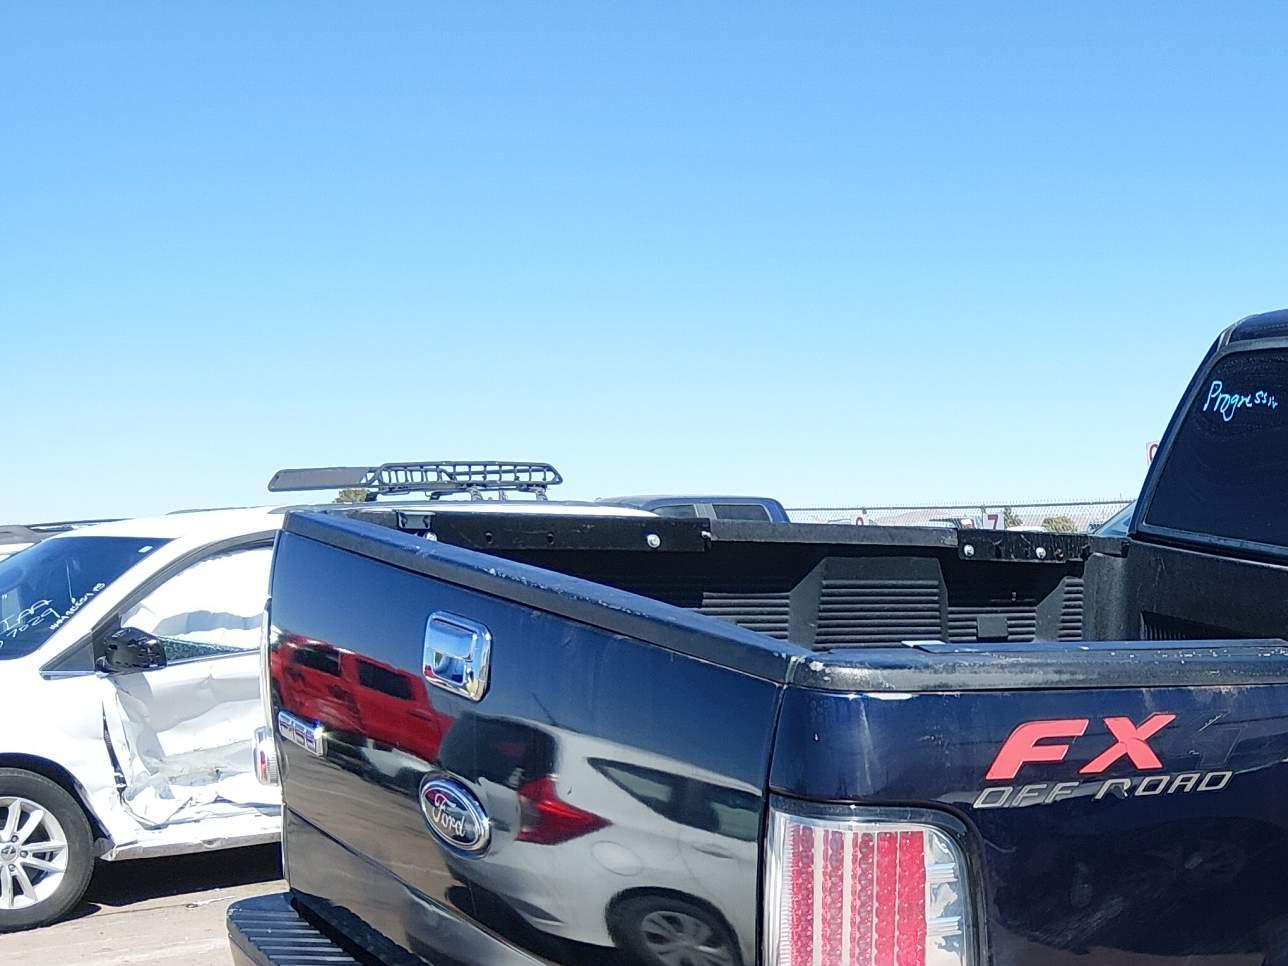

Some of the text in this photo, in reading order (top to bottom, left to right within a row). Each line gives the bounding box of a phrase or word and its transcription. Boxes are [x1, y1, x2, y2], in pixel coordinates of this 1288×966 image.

[985, 713, 1176, 780] FX
[972, 771, 1233, 809] OFF ROAD
[432, 793, 469, 837] Ford
